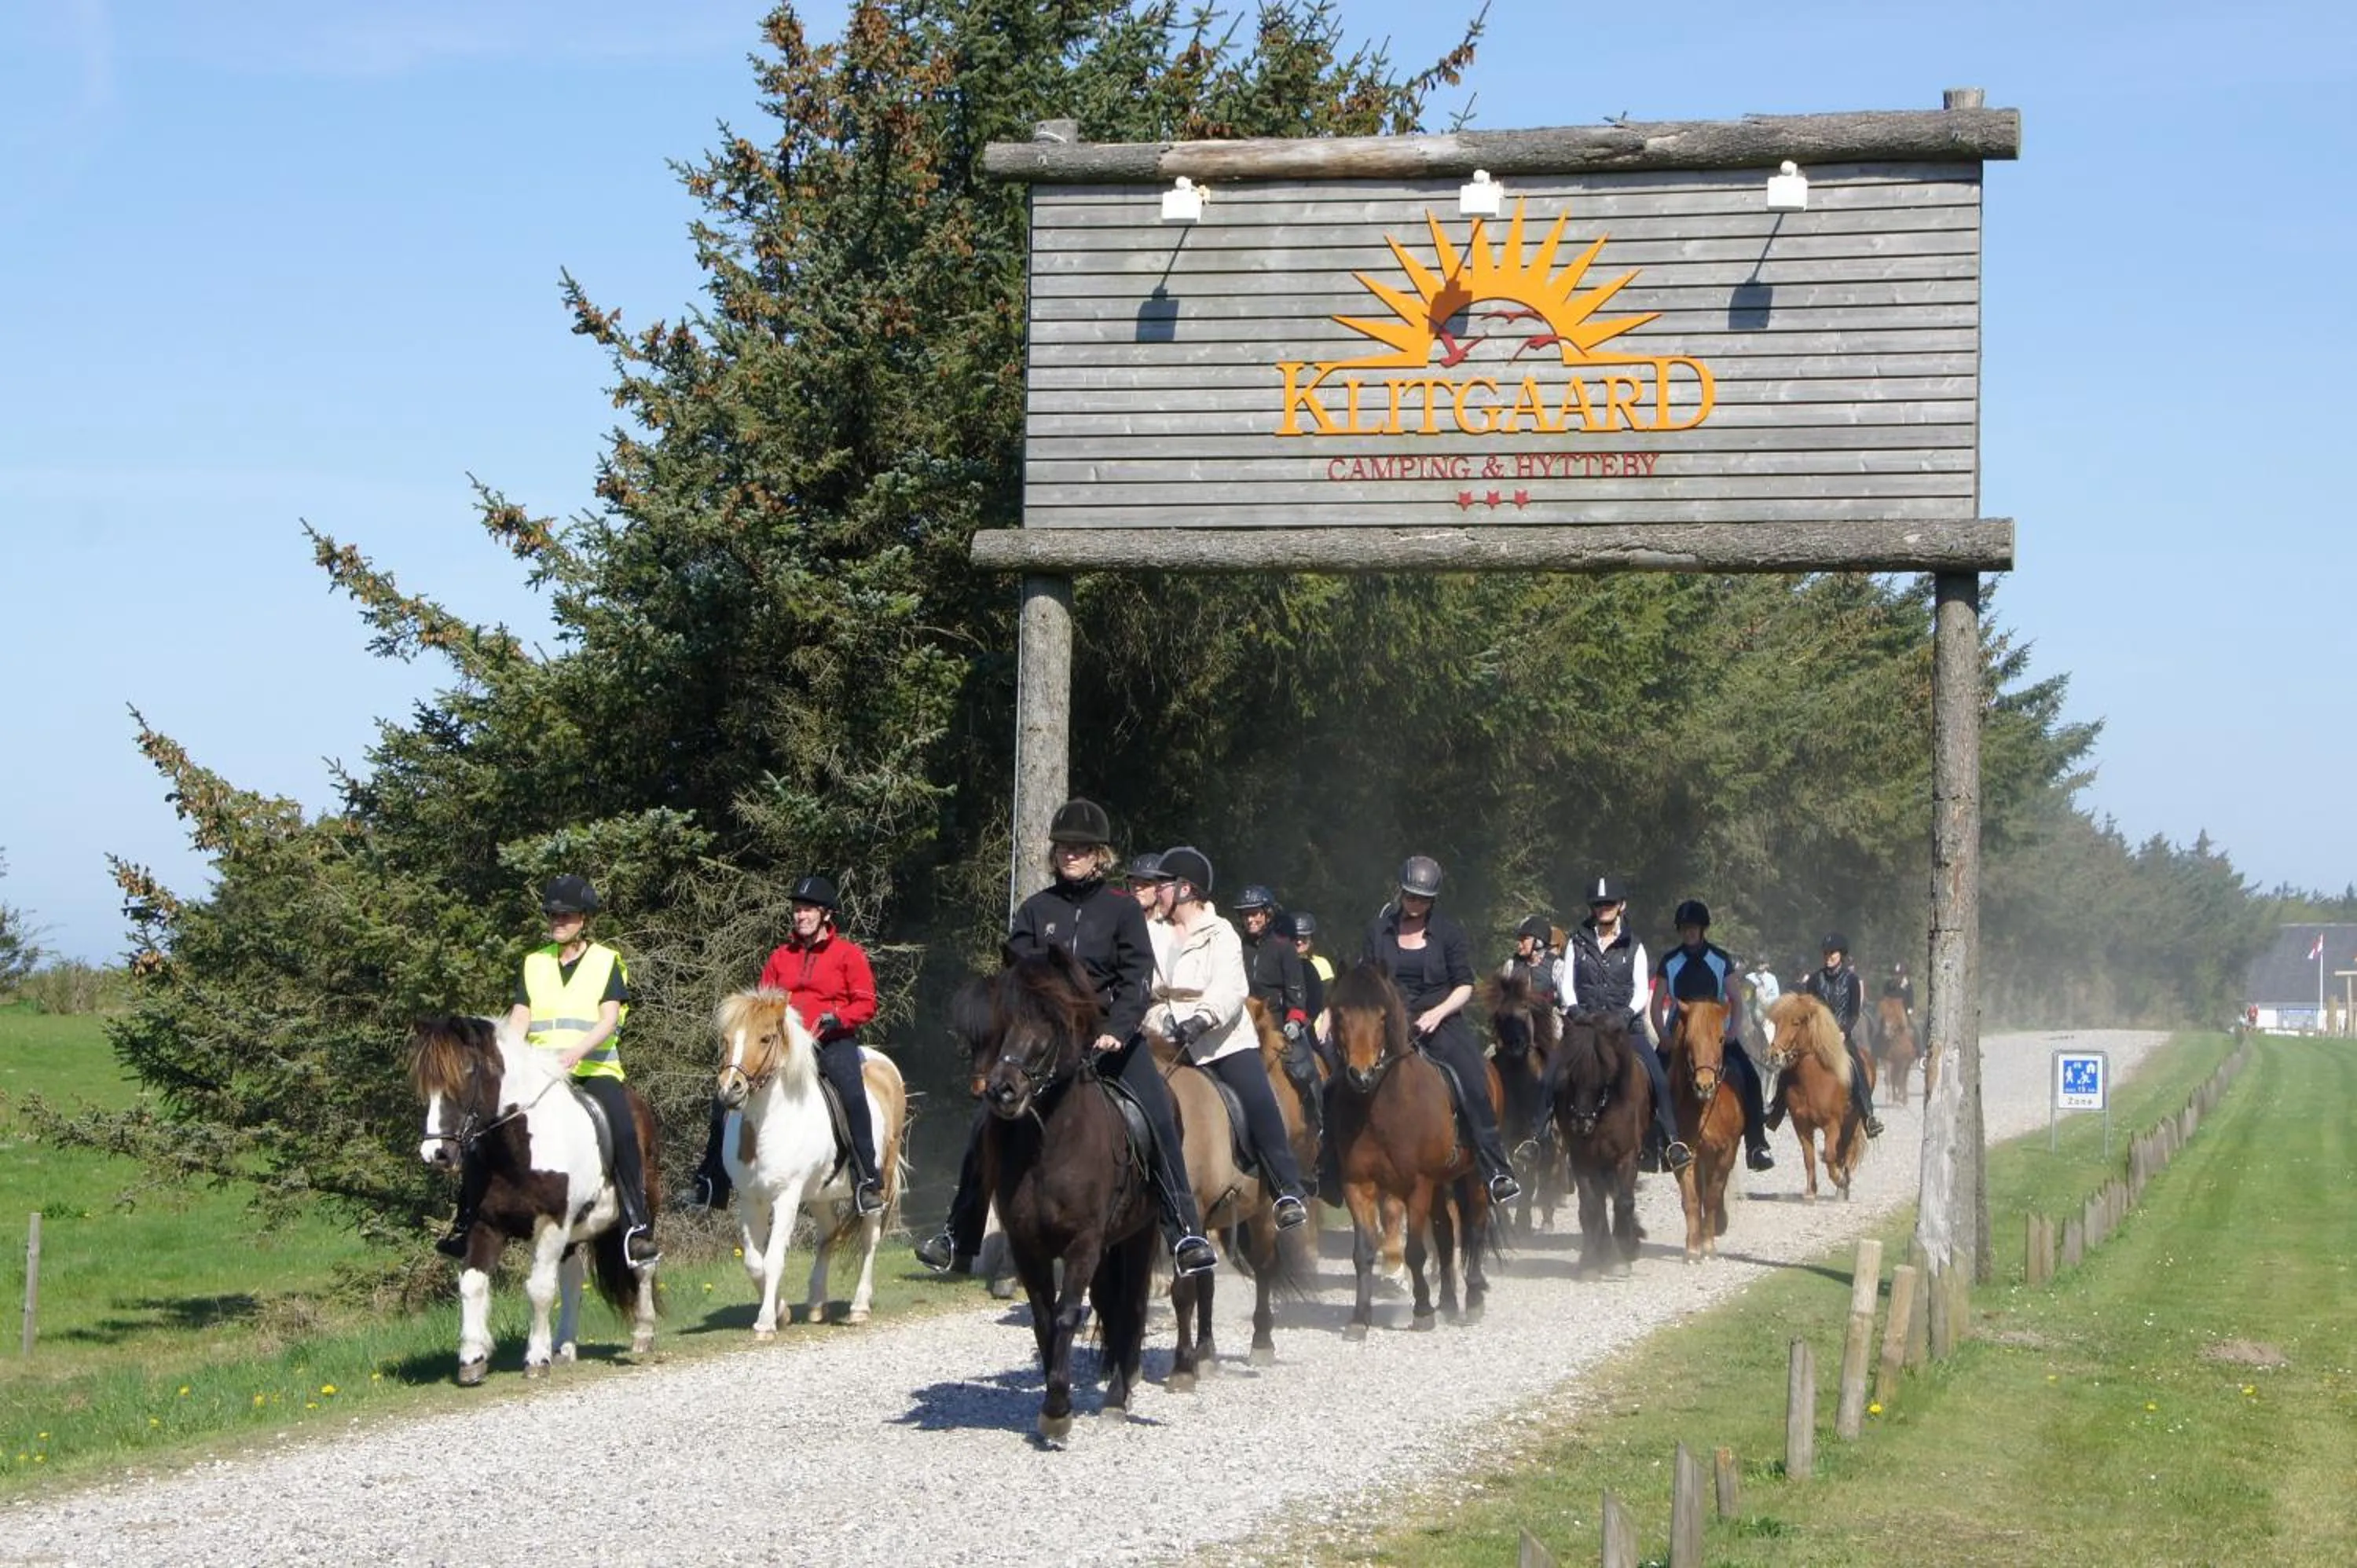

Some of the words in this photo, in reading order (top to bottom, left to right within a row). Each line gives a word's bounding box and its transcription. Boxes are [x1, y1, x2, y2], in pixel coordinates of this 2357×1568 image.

[1276, 357, 1715, 436] KLITGAARD
[1328, 454, 1471, 480] CAMPING
[1482, 453, 1504, 478] &
[1516, 452, 1660, 478] HYTTEBY
